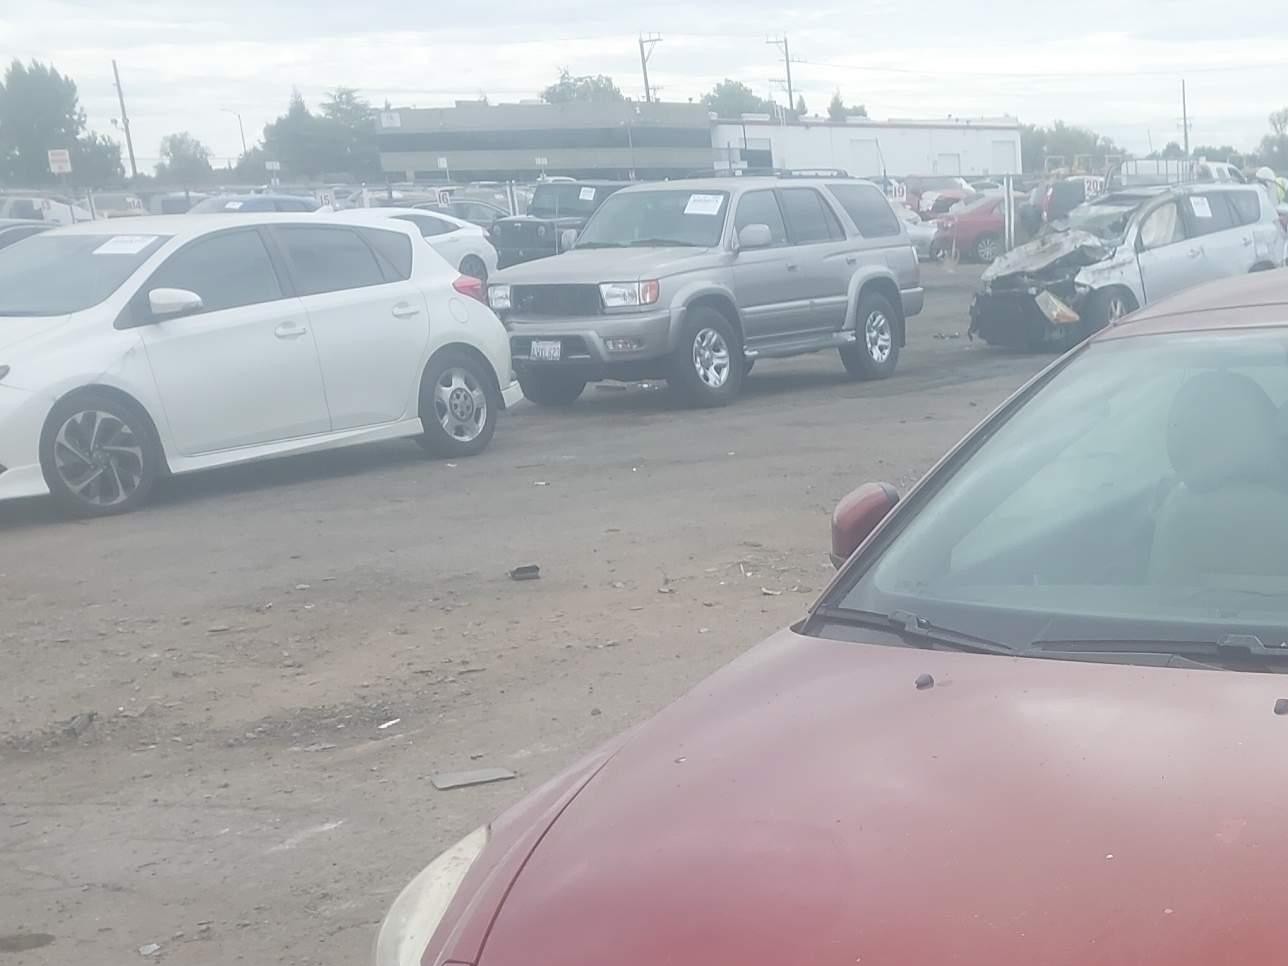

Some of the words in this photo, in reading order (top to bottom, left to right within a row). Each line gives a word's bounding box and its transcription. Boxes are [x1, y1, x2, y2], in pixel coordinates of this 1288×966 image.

[893, 184, 905, 198] 19
[1087, 179, 1099, 193] 20
[319, 191, 330, 205] 15
[437, 190, 449, 203] 16
